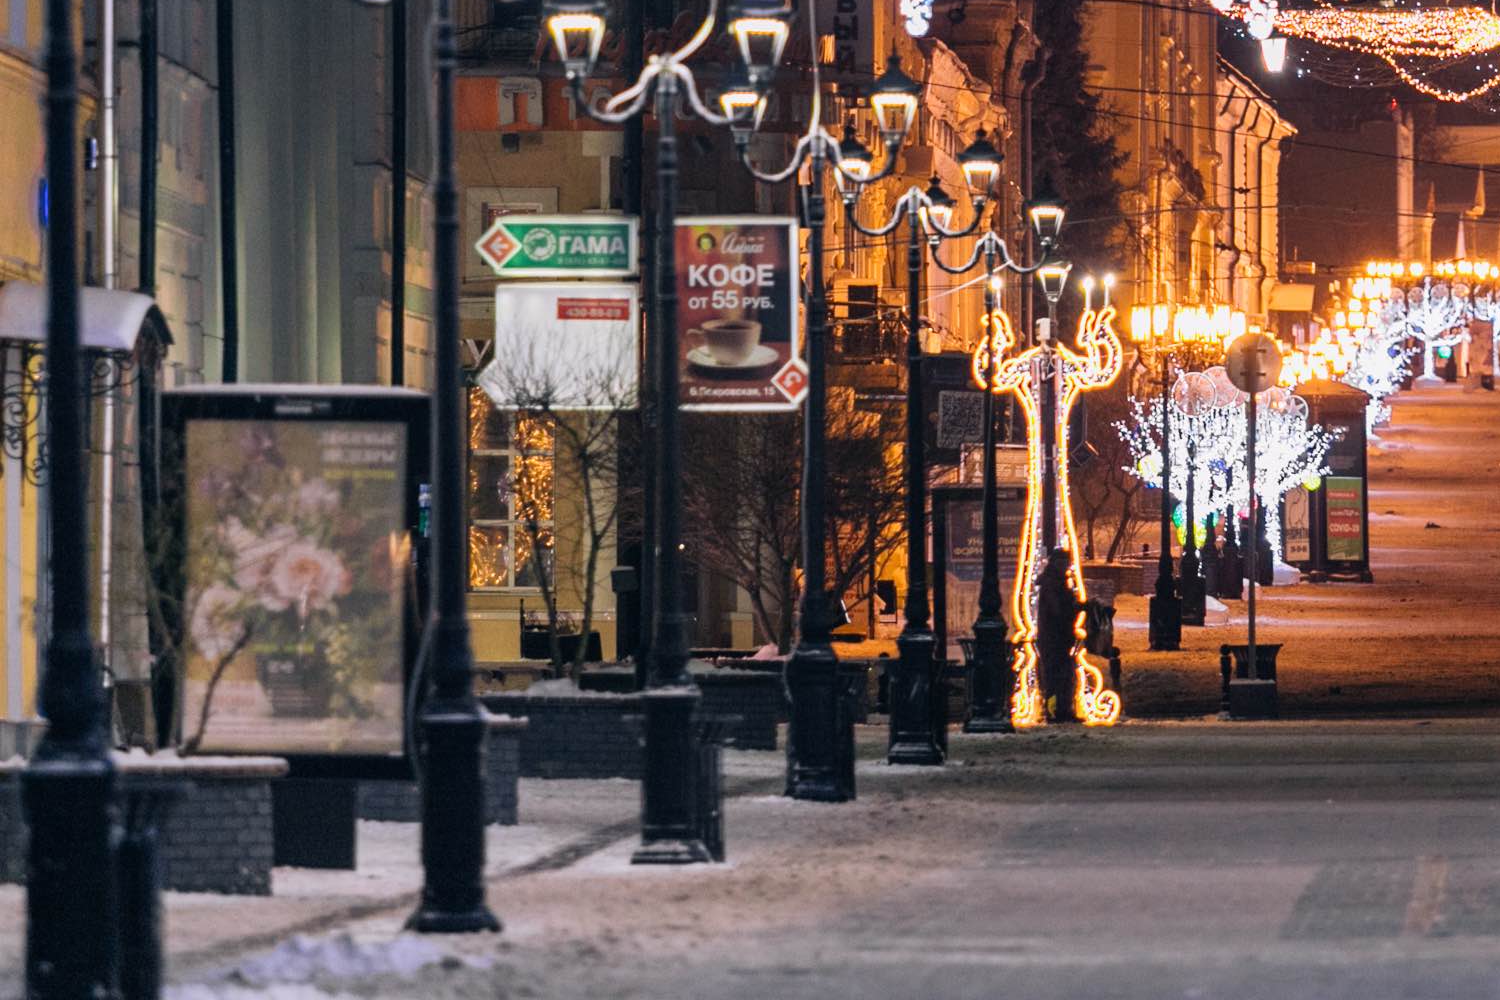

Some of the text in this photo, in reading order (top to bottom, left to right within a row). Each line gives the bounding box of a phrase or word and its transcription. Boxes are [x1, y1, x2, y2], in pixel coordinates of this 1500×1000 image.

[558, 235, 626, 254] ГАМА
[688, 264, 774, 287] КОФЕ
[712, 290, 738, 309] 55
